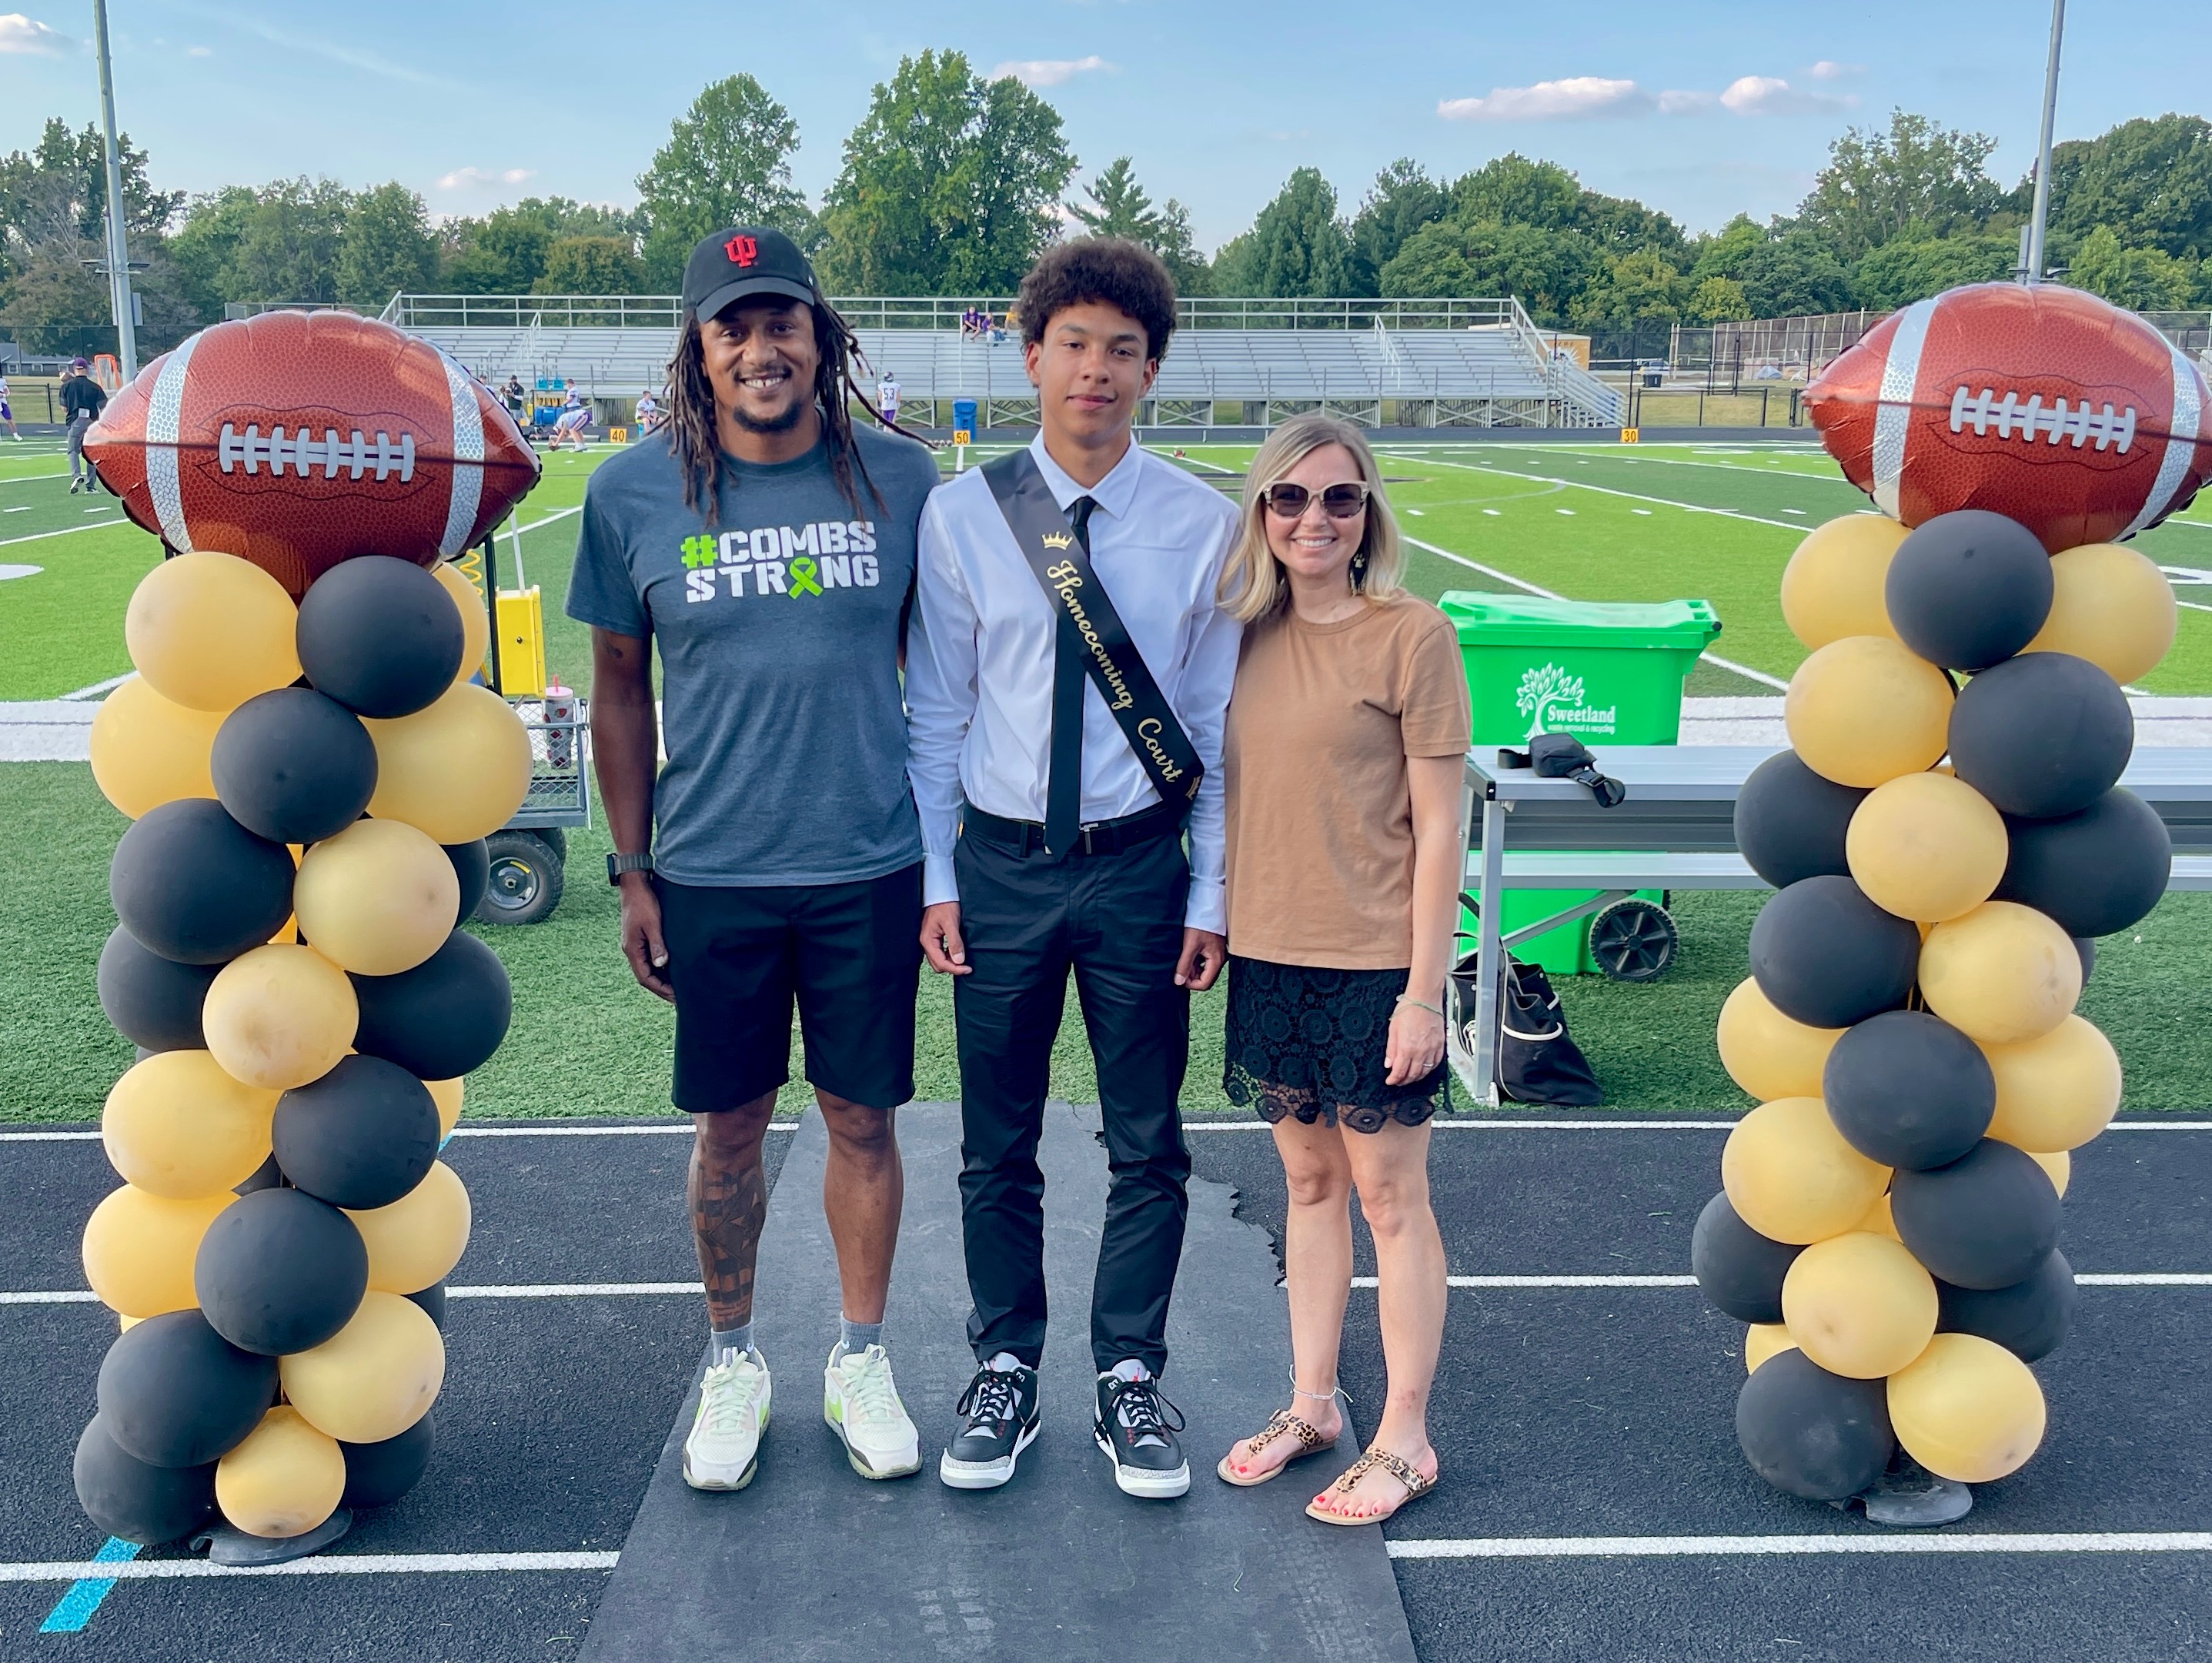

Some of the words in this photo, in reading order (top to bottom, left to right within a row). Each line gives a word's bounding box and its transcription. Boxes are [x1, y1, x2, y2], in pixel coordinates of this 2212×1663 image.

[612, 429, 624, 442] 40
[956, 432, 968, 444] 50
[1624, 430, 1636, 442] 30
[680, 520, 877, 569] #COMBS
[1046, 559, 1134, 710] Homecoming
[1138, 717, 1184, 783] Court
[1548, 704, 1616, 723] Sweetland
